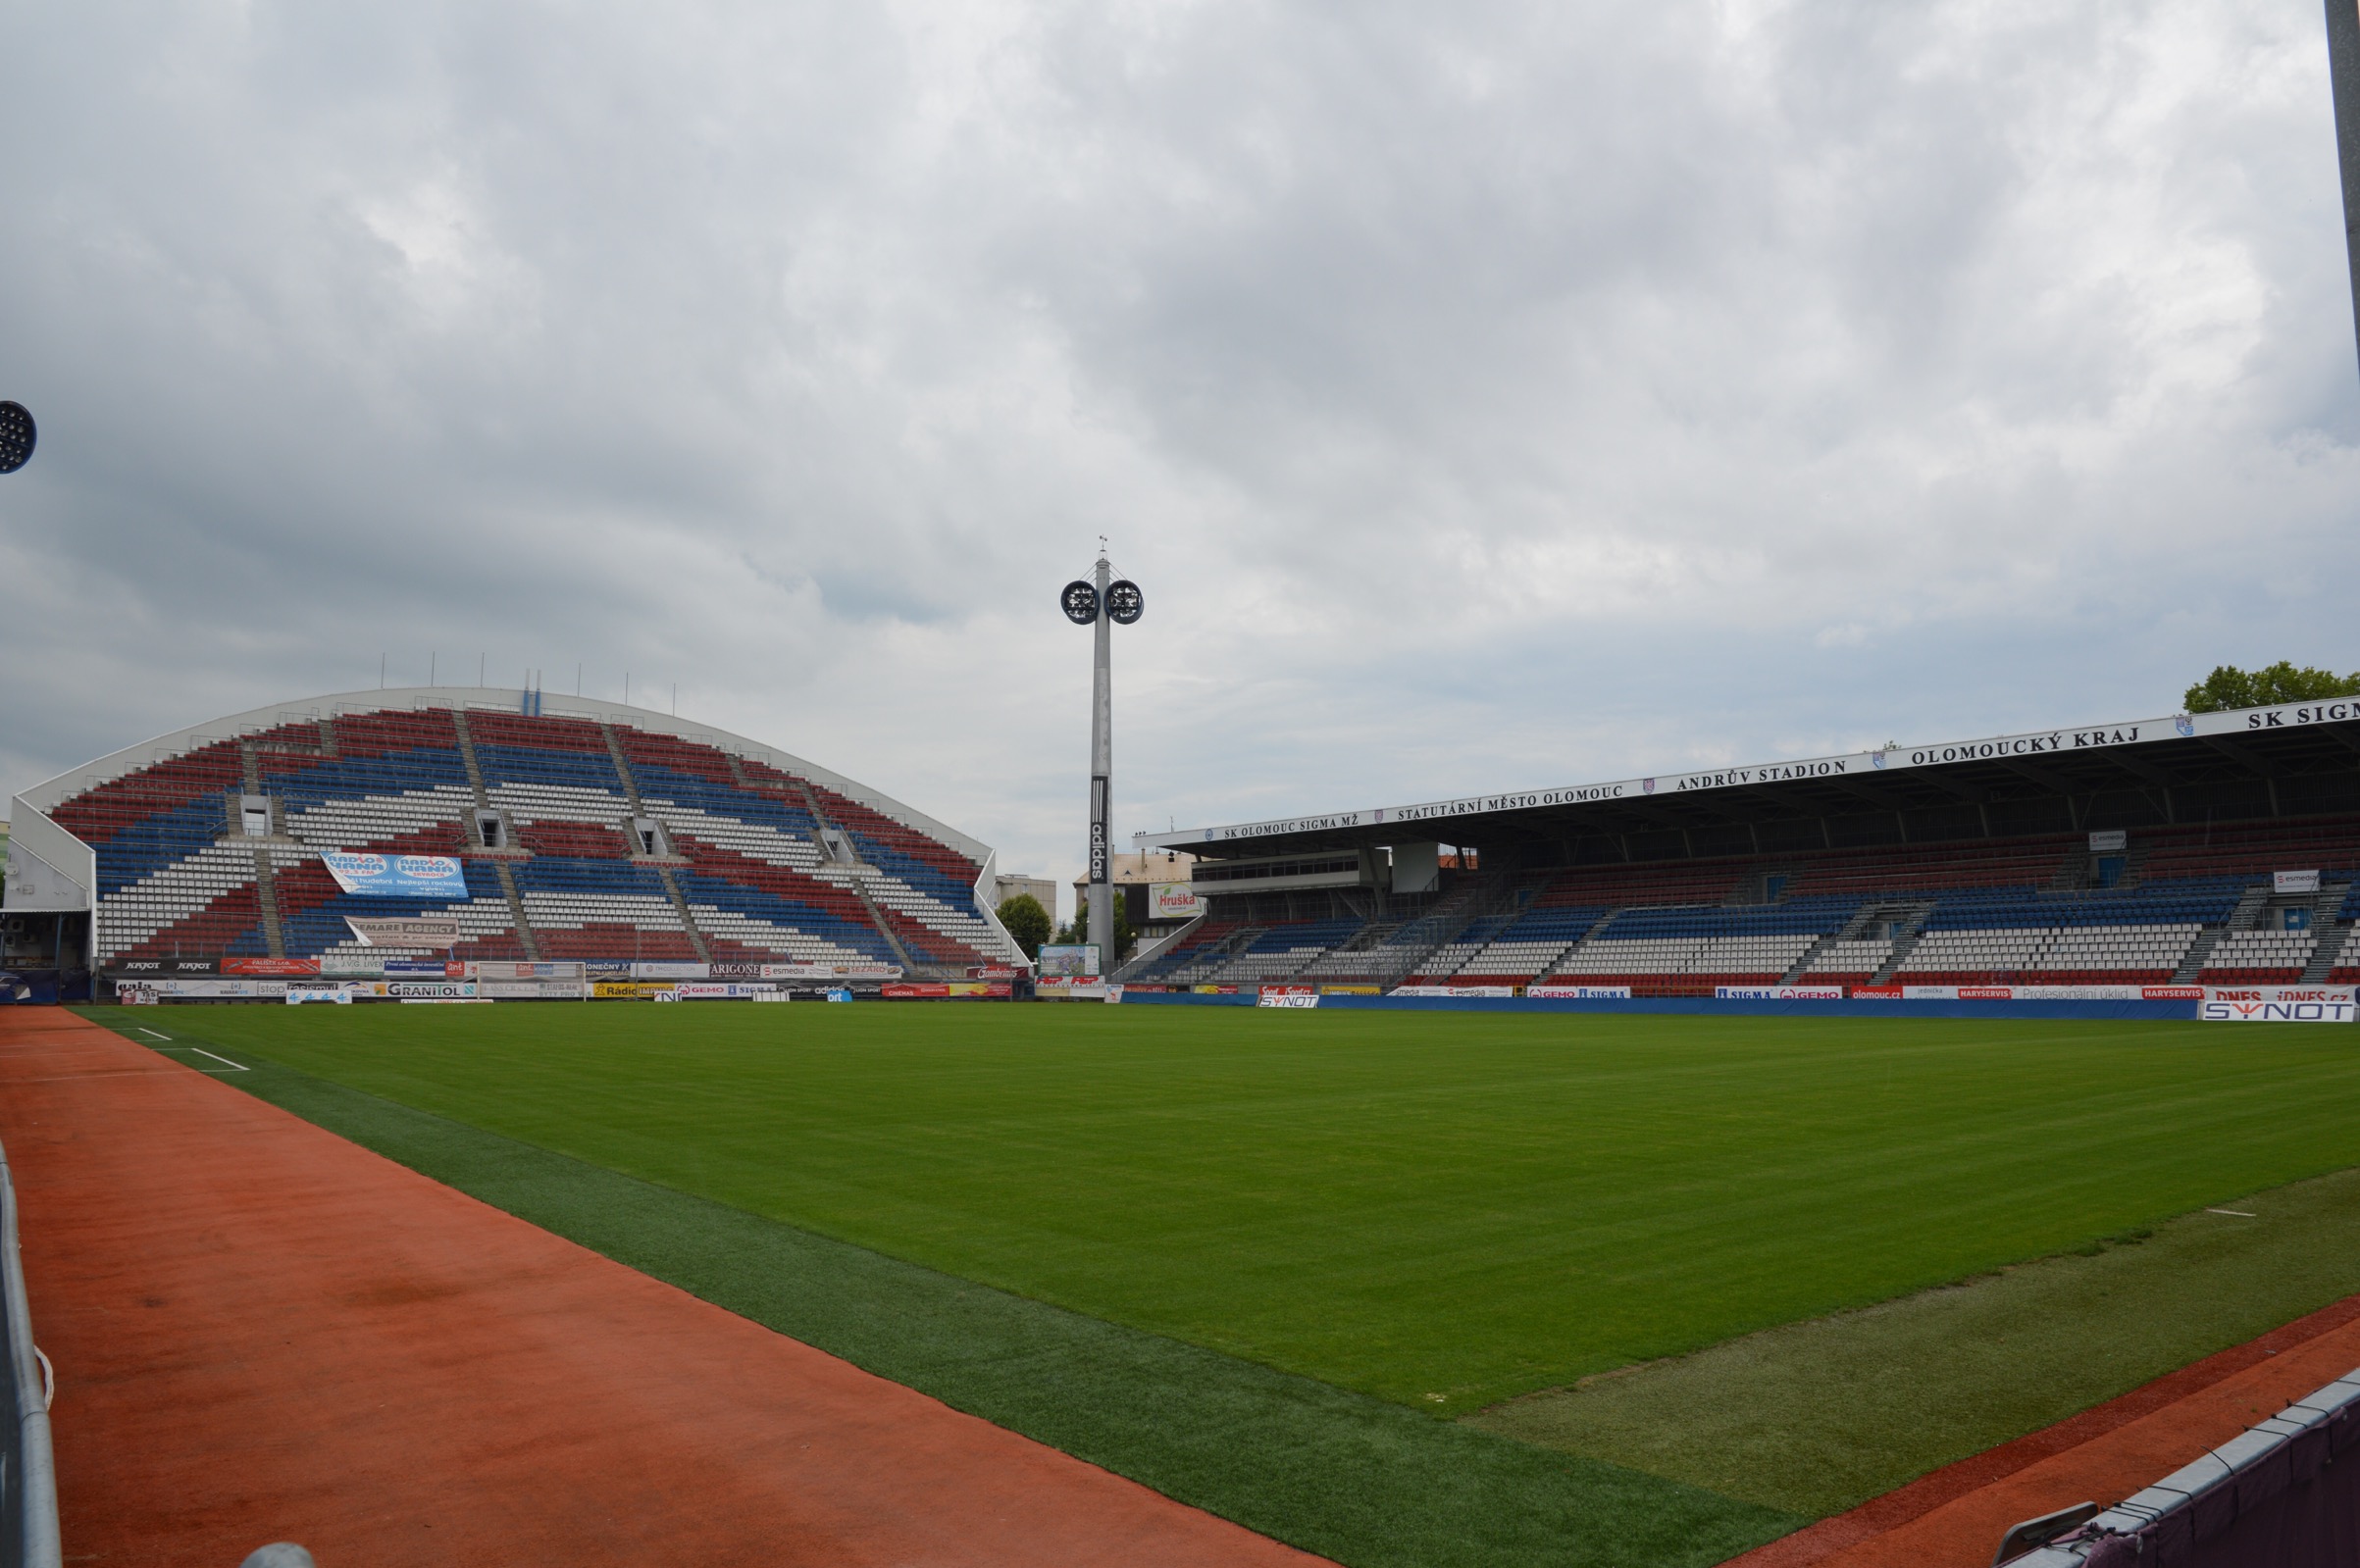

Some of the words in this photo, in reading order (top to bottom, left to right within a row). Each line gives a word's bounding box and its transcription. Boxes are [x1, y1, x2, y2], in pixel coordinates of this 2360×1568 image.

[2248, 711, 2283, 729] SK
[1912, 733, 2062, 765] OLOMOUCKÝ
[2074, 727, 2139, 747] KRAJ
[1676, 769, 1751, 790] ANDRŮV
[1759, 760, 1846, 782] STADION
[1398, 798, 1482, 821] STATUTÁRNÍ
[1488, 794, 1537, 811] MĚSTO
[1544, 785, 1623, 804] OLOMOUC
[1224, 829, 1238, 838] SK
[1241, 823, 1296, 837] OLOMOUC
[1300, 818, 1337, 831] SIGMA
[1341, 813, 1359, 826] MŽ
[1092, 824, 1105, 880] adidas
[1159, 892, 1196, 906] Hruška
[405, 924, 453, 934] AGENCY
[126, 962, 161, 971] KAJOT
[177, 962, 212, 971] KAJOT
[710, 964, 760, 975] ARIGONE
[260, 984, 285, 995] stop
[606, 986, 637, 995] Rádio
[1731, 990, 1770, 999] SIGMA
[1853, 990, 1901, 999] olomouc.cz
[2023, 988, 2097, 999] Profesionální
[2100, 988, 2129, 999] úklid
[1260, 996, 1316, 1006] SYNOT
[2277, 990, 2348, 1001] iDNEScz
[2205, 1003, 2353, 1020] SYNOT
